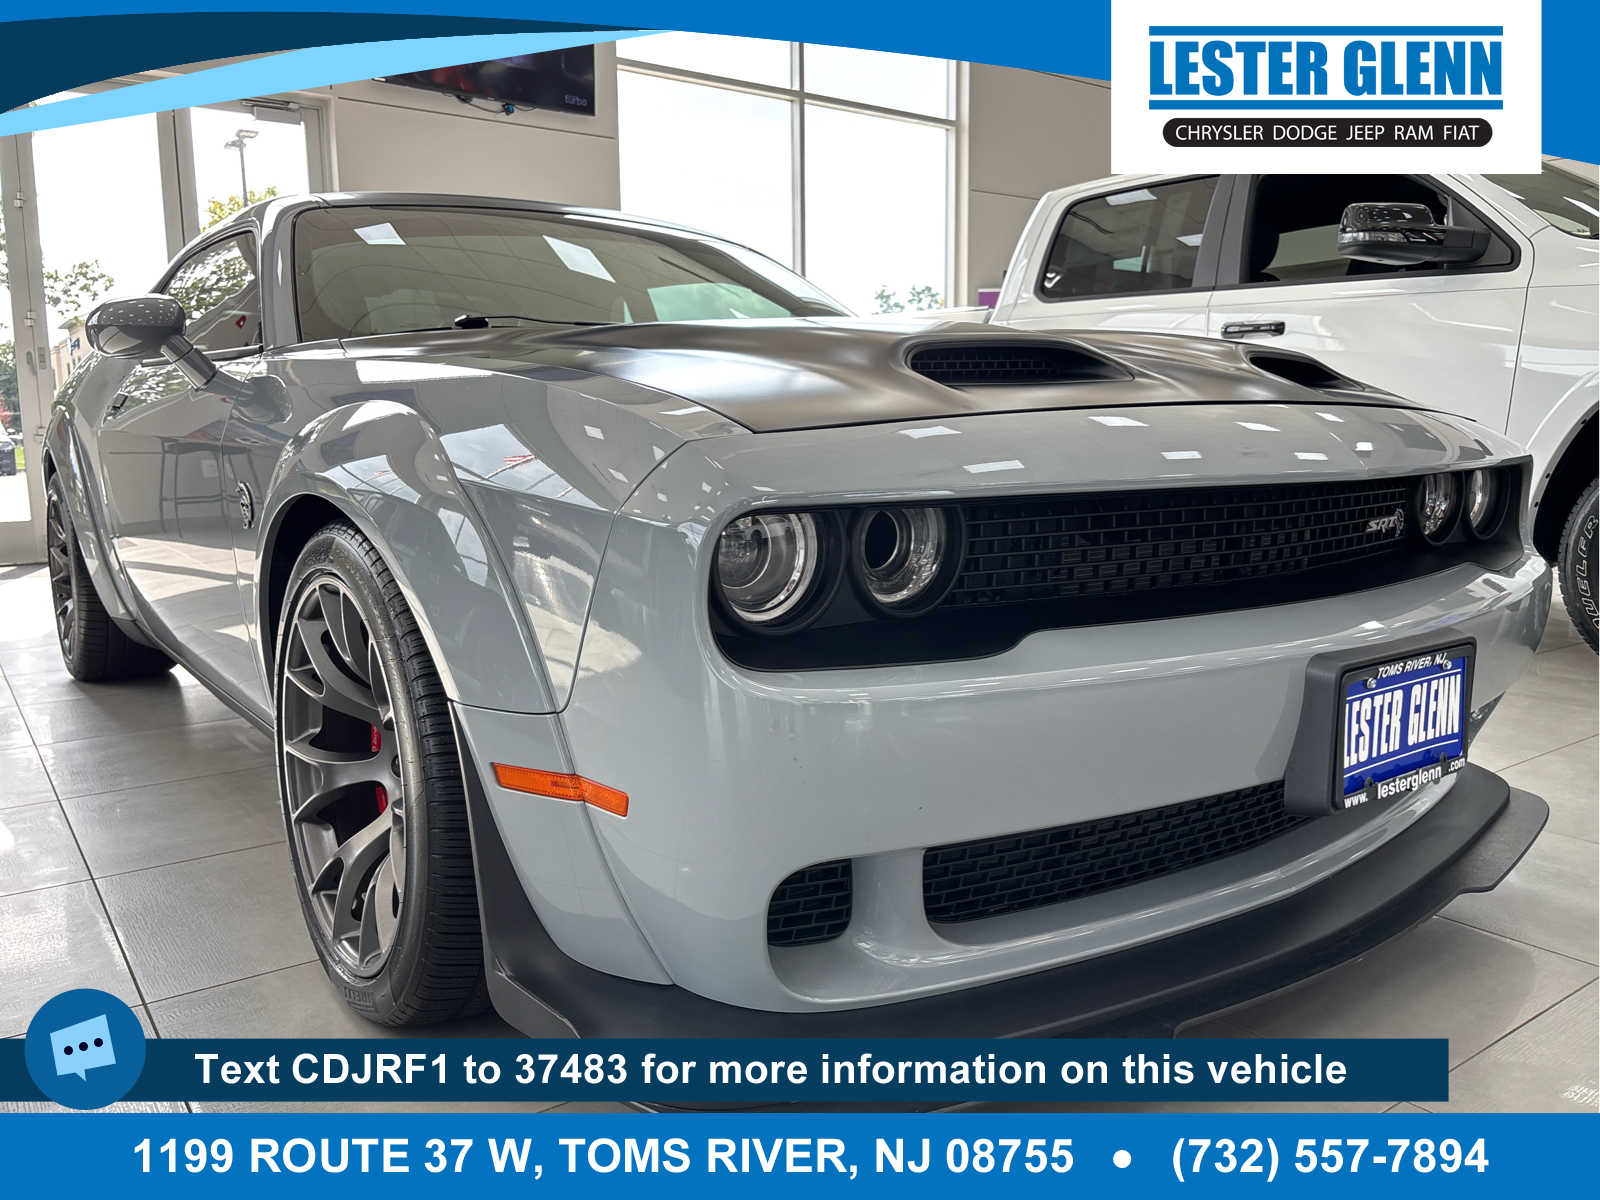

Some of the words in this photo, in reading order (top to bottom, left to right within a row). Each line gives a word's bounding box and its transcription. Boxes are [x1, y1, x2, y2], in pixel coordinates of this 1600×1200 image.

[564, 95, 588, 106] turbo
[1366, 516, 1397, 533] SRT
[1377, 662, 1404, 679] TOMS
[1343, 689, 1404, 769] LESTER
[1407, 674, 1462, 746] GLENN
[1344, 792, 1368, 809] www.
[1377, 765, 1442, 799] lesterglenn
[1448, 757, 1466, 773] .com
